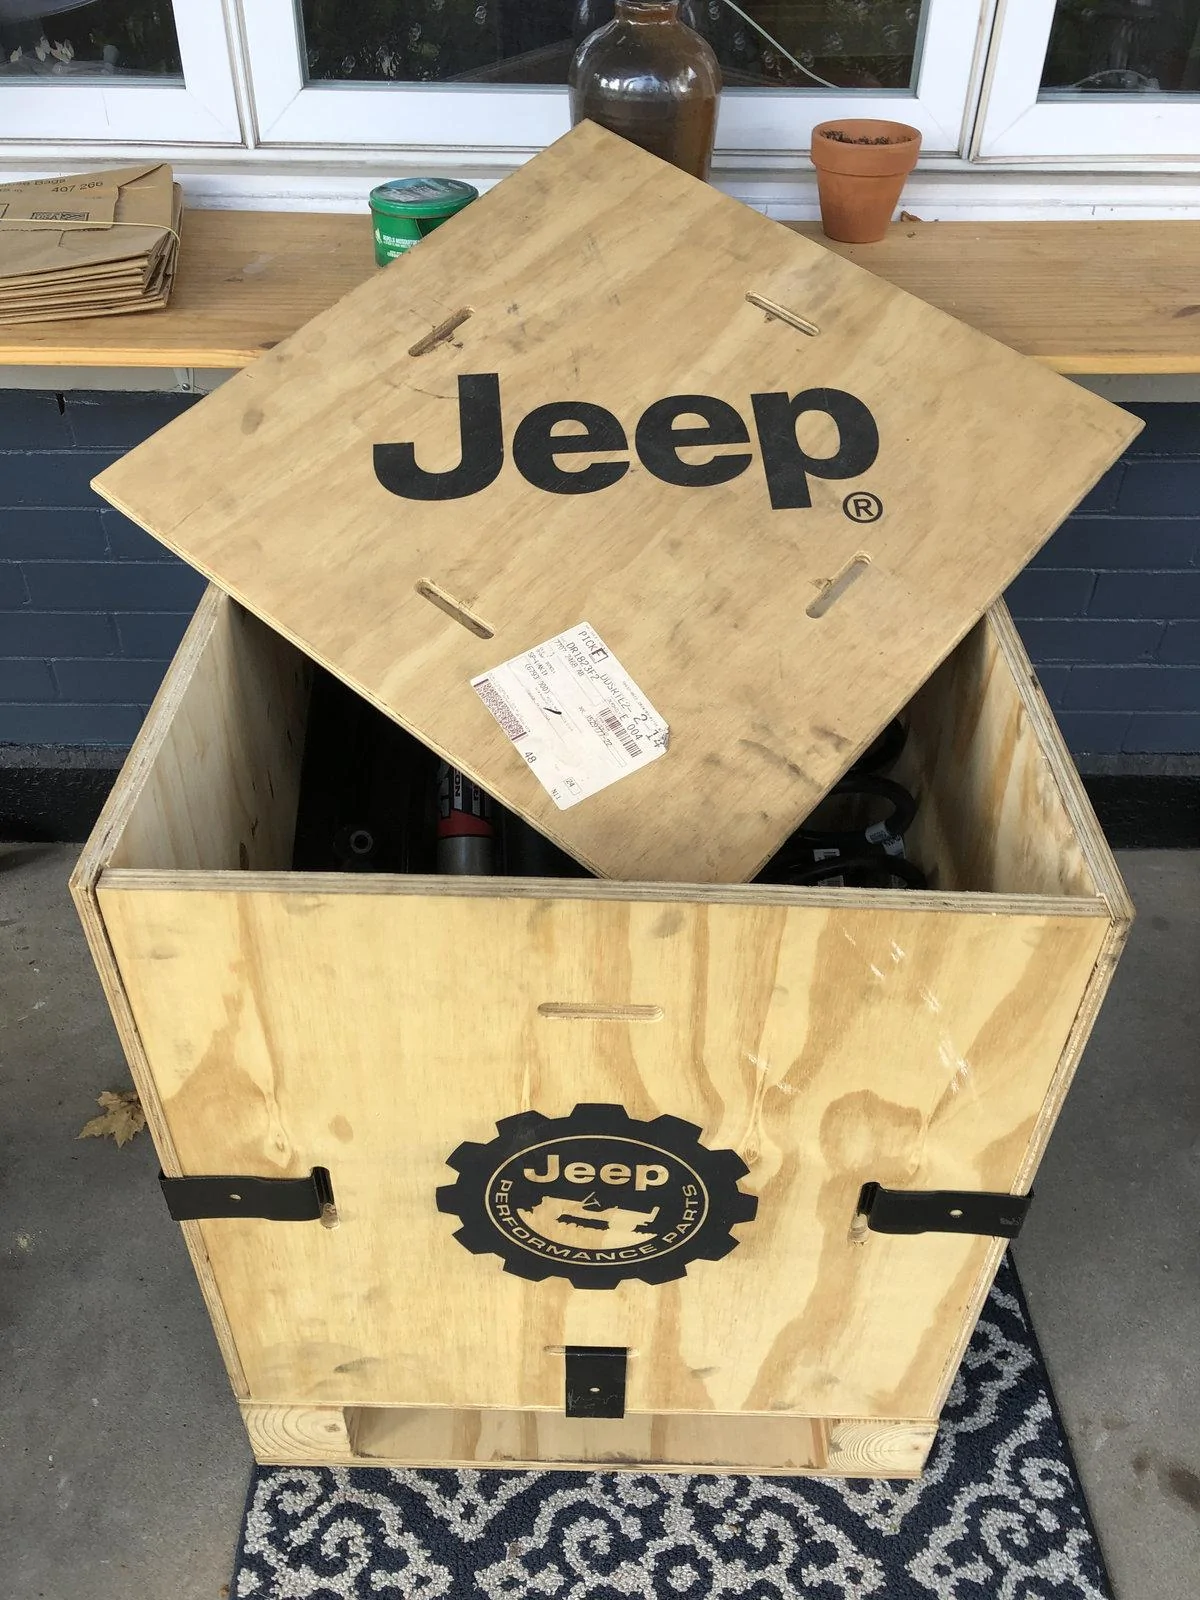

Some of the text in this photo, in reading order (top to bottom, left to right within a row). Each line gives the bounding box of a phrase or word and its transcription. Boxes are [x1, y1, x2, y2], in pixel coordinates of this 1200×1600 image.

[52, 185, 76, 193] 407
[372, 373, 880, 511] Jeep
[522, 749, 537, 764] 48
[523, 1154, 670, 1191] Jeep
[495, 1179, 698, 1261] PERFORMANCE PARTS
